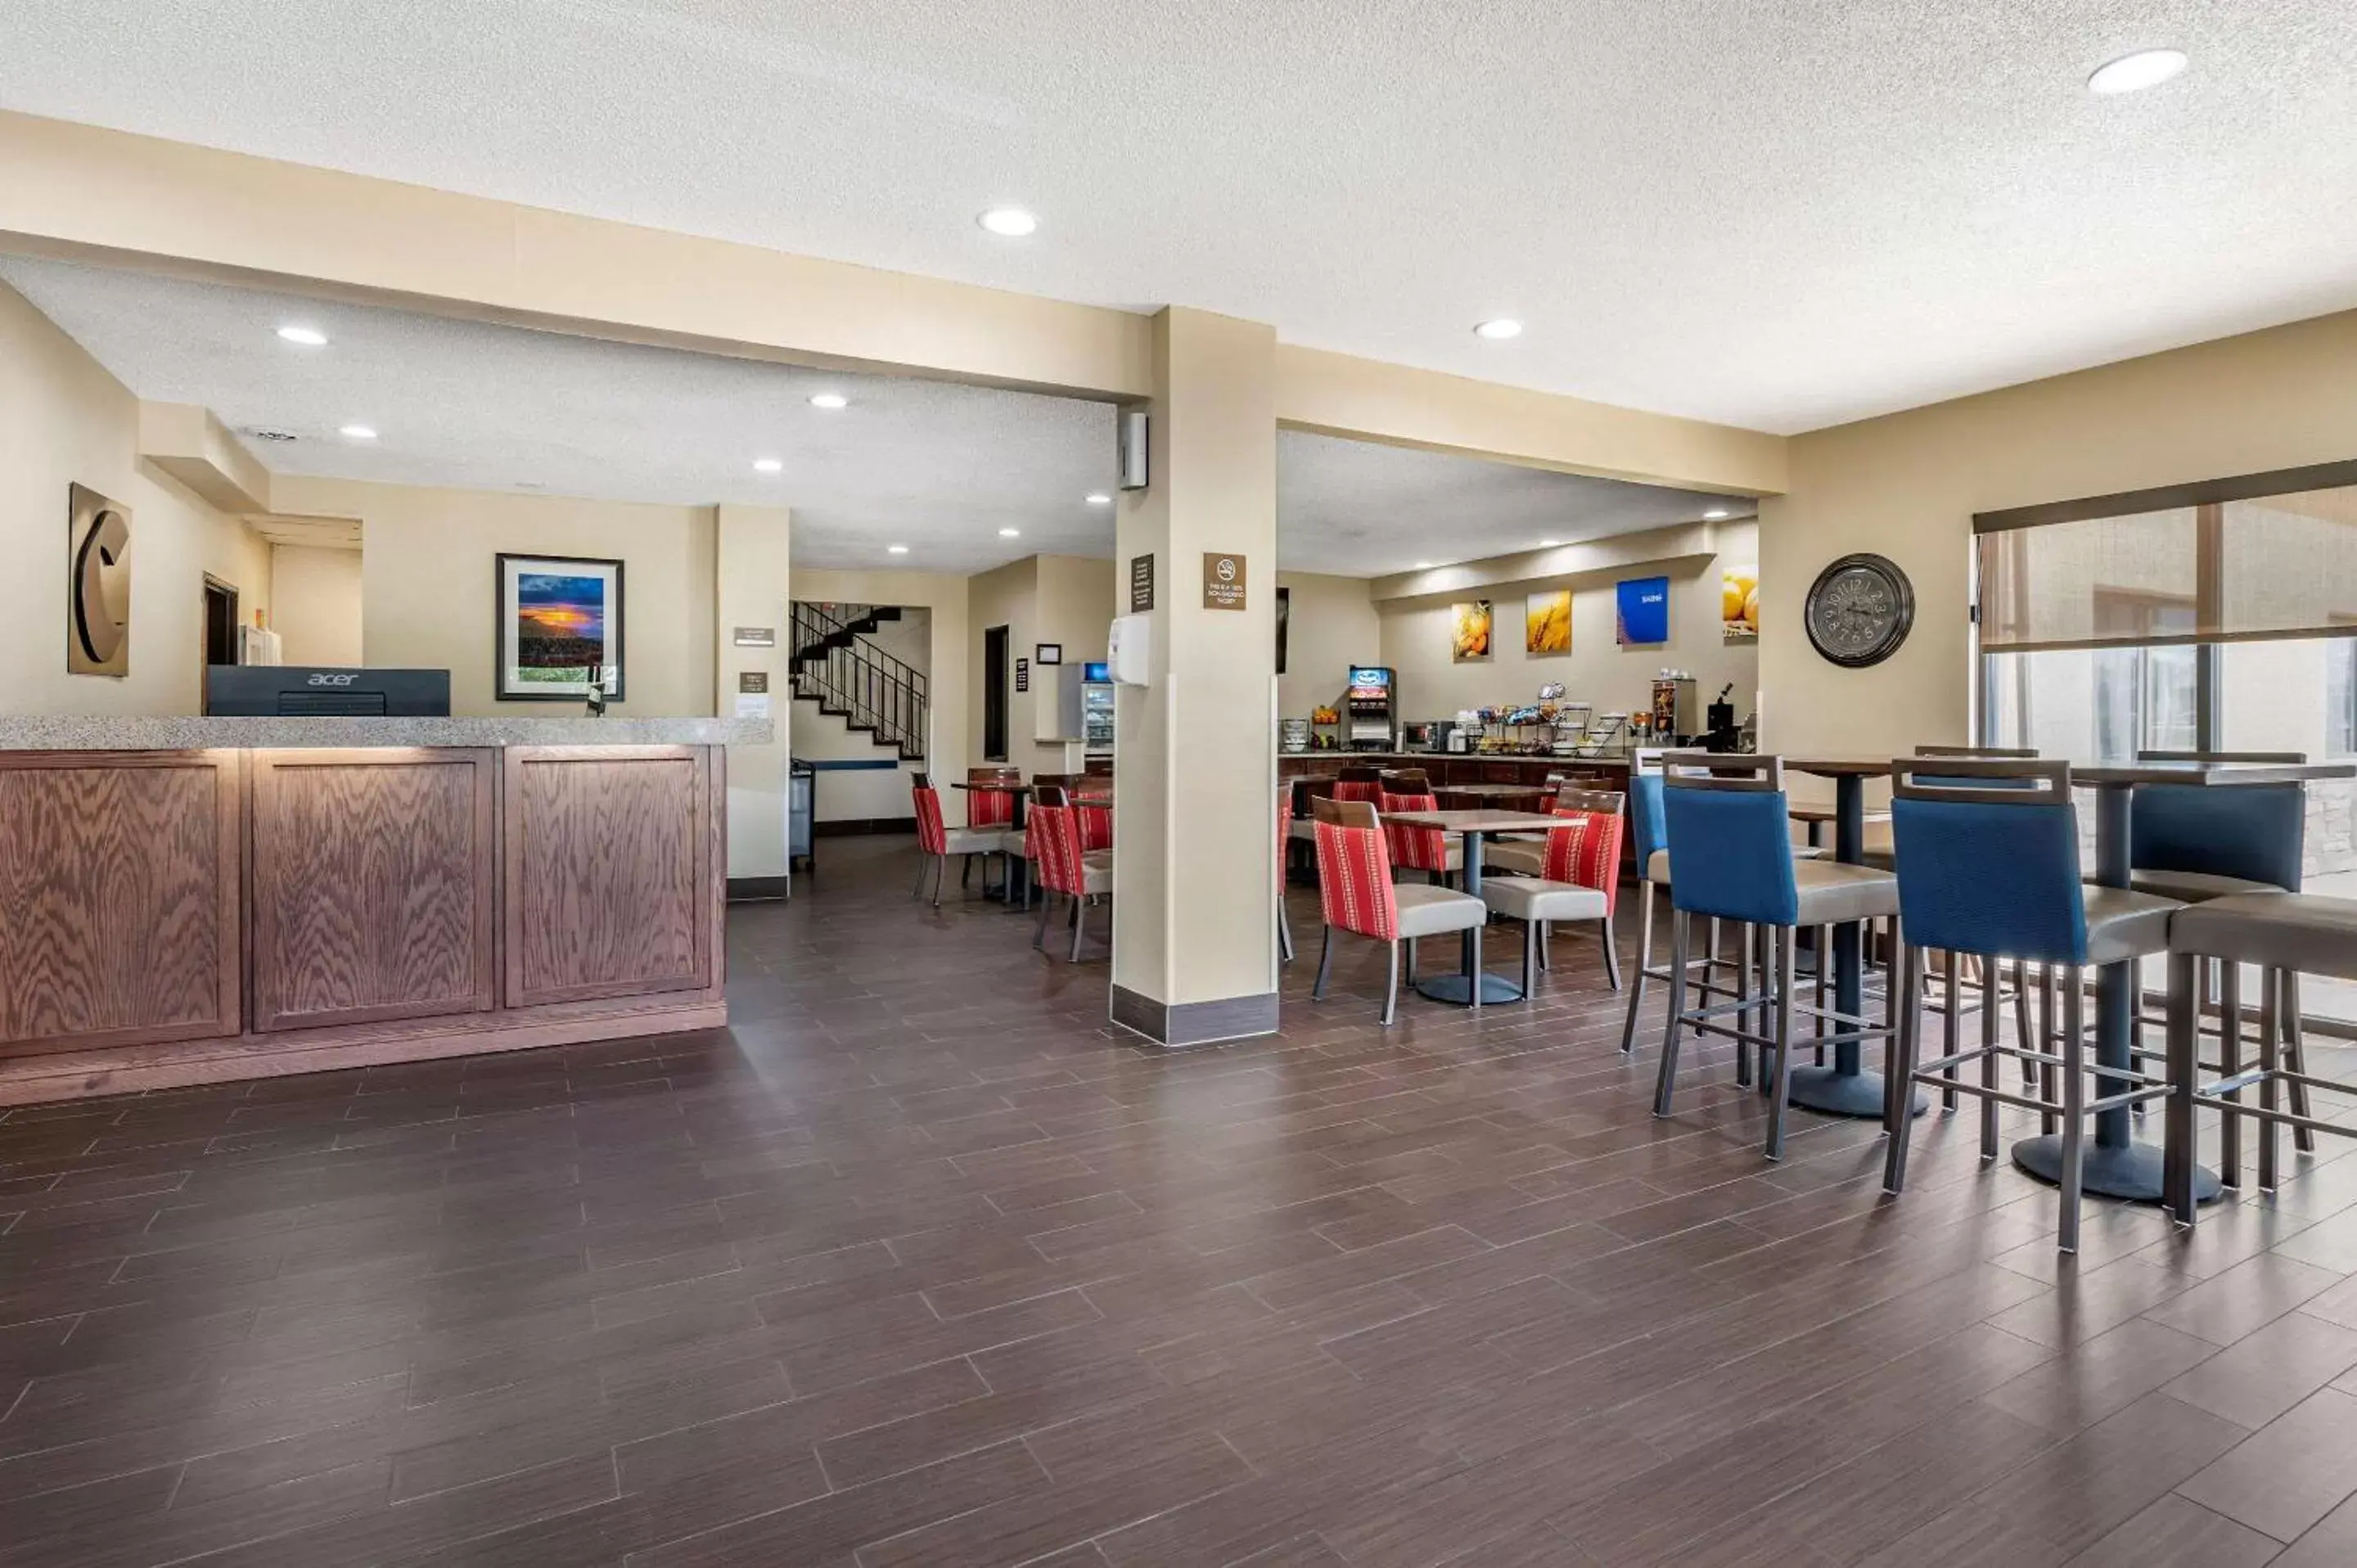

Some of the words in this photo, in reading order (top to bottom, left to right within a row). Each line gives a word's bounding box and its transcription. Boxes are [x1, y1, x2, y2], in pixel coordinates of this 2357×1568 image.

[1850, 579, 1861, 590] 12
[1865, 581, 1871, 593] 1
[1828, 593, 1841, 606] 10
[1871, 590, 1882, 602] 2
[1824, 610, 1836, 618] 9
[1874, 604, 1886, 612] 3
[1851, 632, 1860, 642] 6
[1864, 627, 1873, 639] 5
[307, 674, 359, 686] acer
